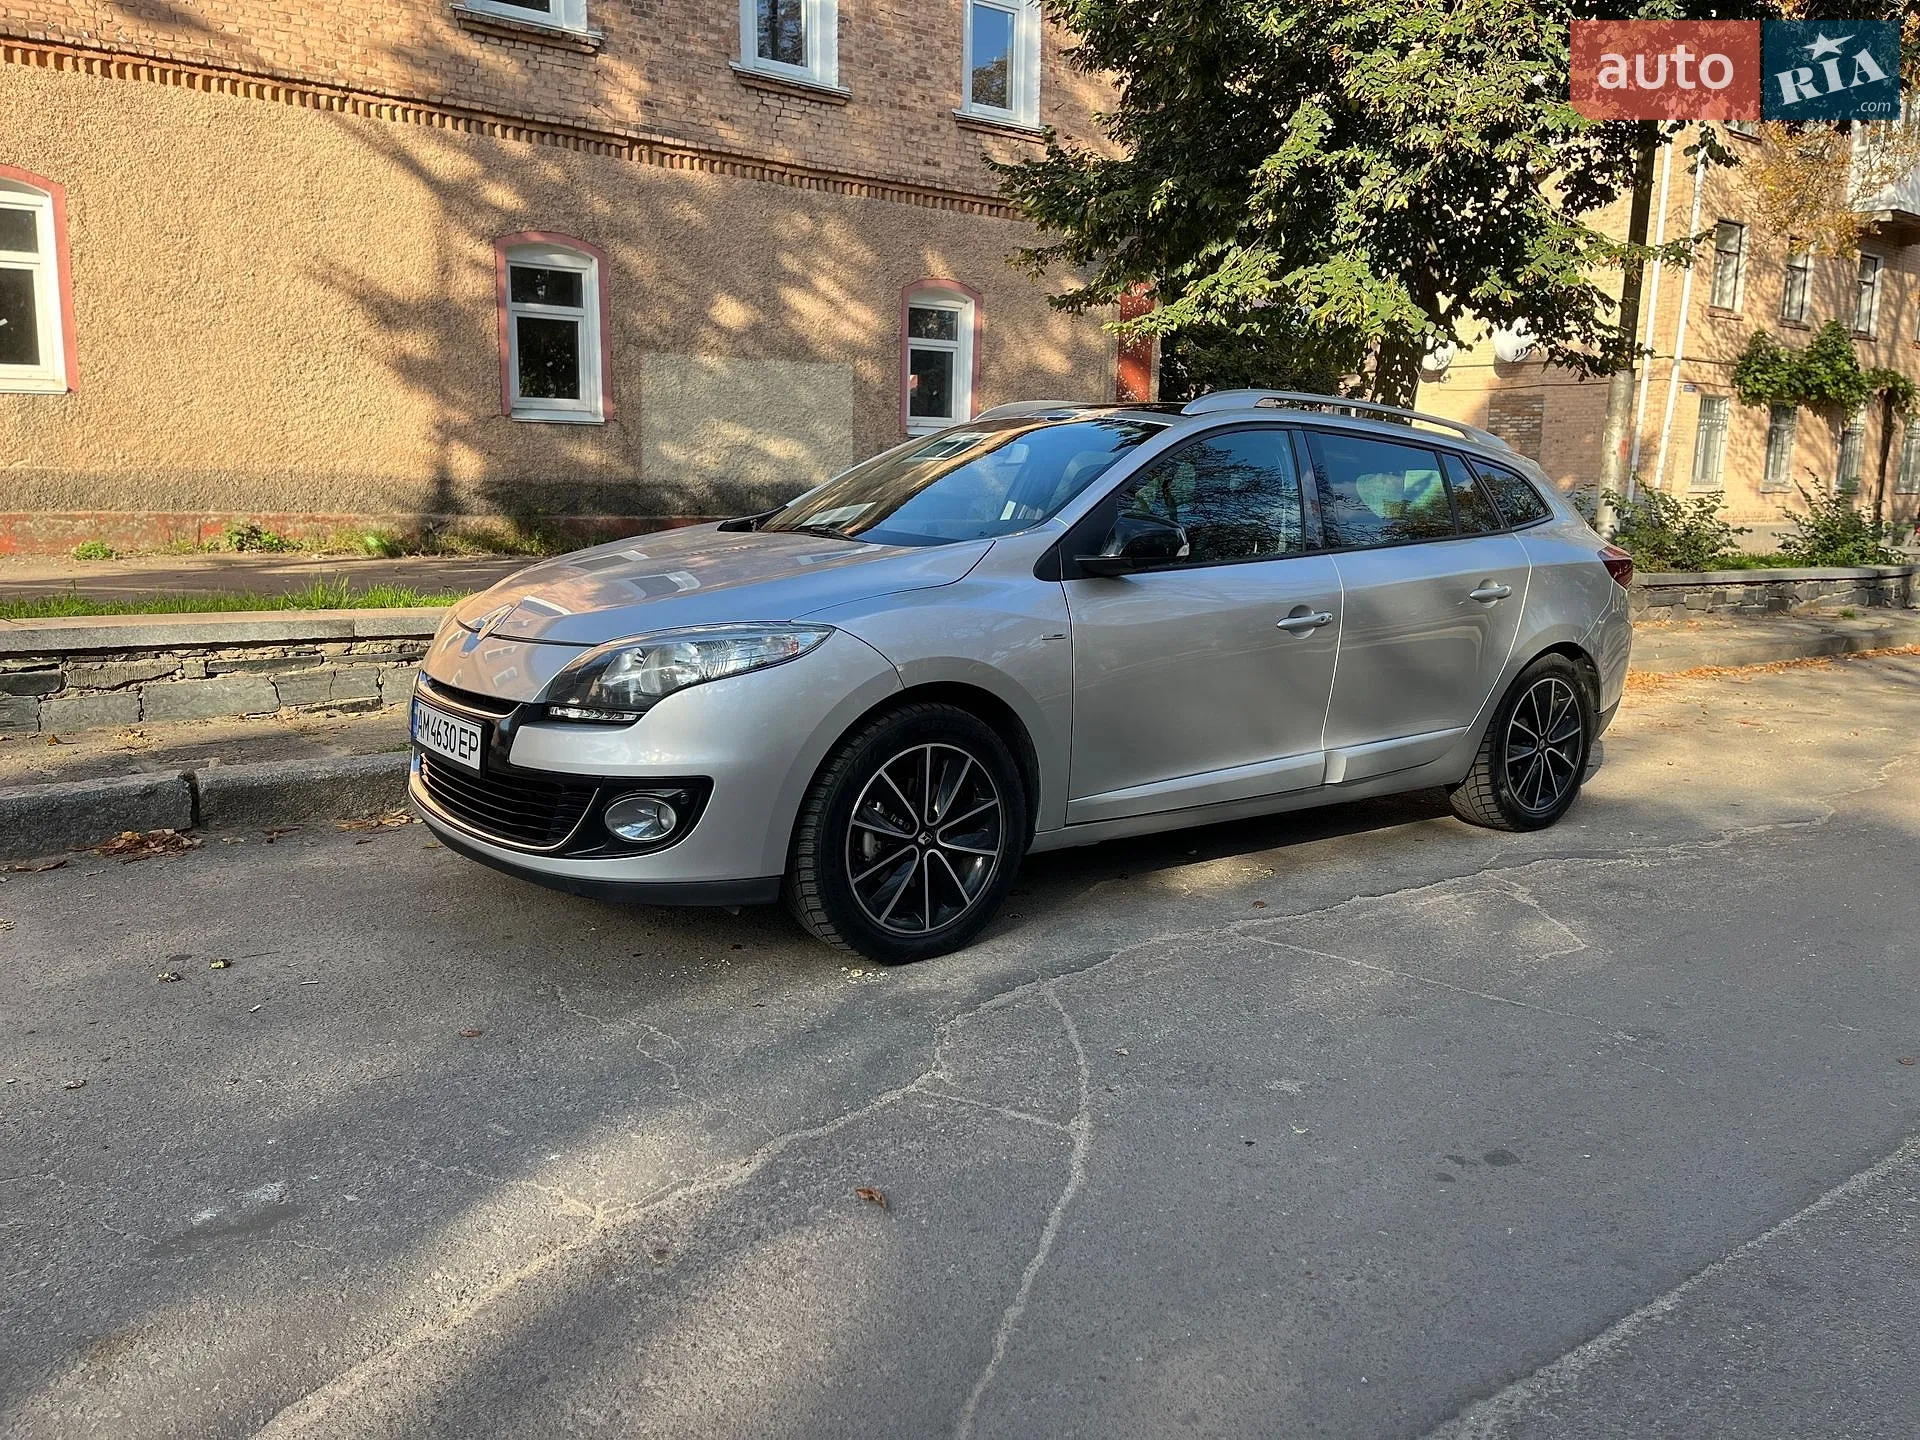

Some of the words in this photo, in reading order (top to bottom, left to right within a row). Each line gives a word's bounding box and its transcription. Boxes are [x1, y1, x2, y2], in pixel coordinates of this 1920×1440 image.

[417, 709, 430, 742] AM
[430, 716, 456, 753] 4630
[458, 726, 479, 760] EP
